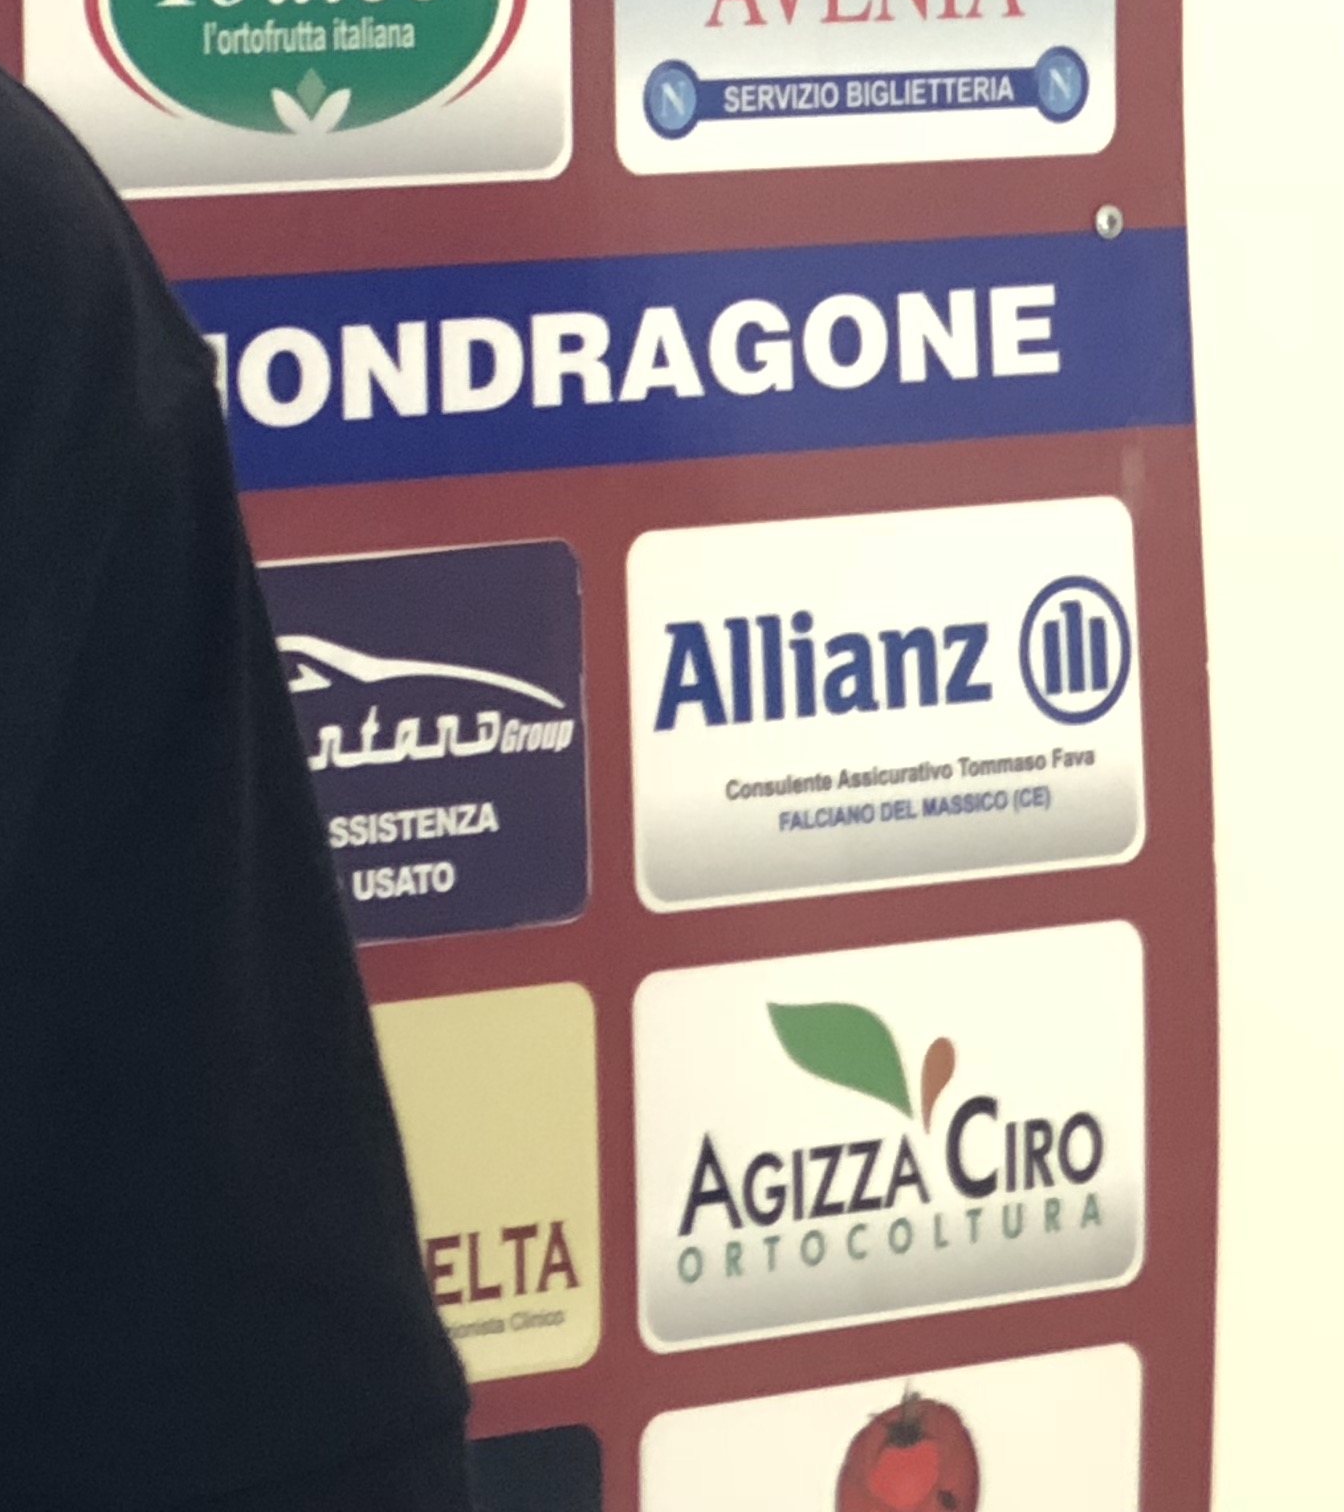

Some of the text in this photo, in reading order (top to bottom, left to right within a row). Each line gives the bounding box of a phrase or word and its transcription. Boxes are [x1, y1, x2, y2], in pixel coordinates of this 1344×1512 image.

[203, 16, 415, 55] l'ortofrutta italiana
[723, 80, 840, 114] SERVIZIO
[846, 75, 1015, 108] BIGLIETTERIA
[203, 283, 1062, 429] ONDRAGONE
[653, 609, 993, 733] Allianz
[501, 718, 575, 754] Group
[725, 747, 1096, 801] Consulente Assicurativo Tommaso Fava
[778, 785, 1052, 832] FALCIANO DEL MASSICO (CE)
[351, 861, 456, 902] USATO
[677, 1193, 1103, 1285] ORTOCOLTURA
